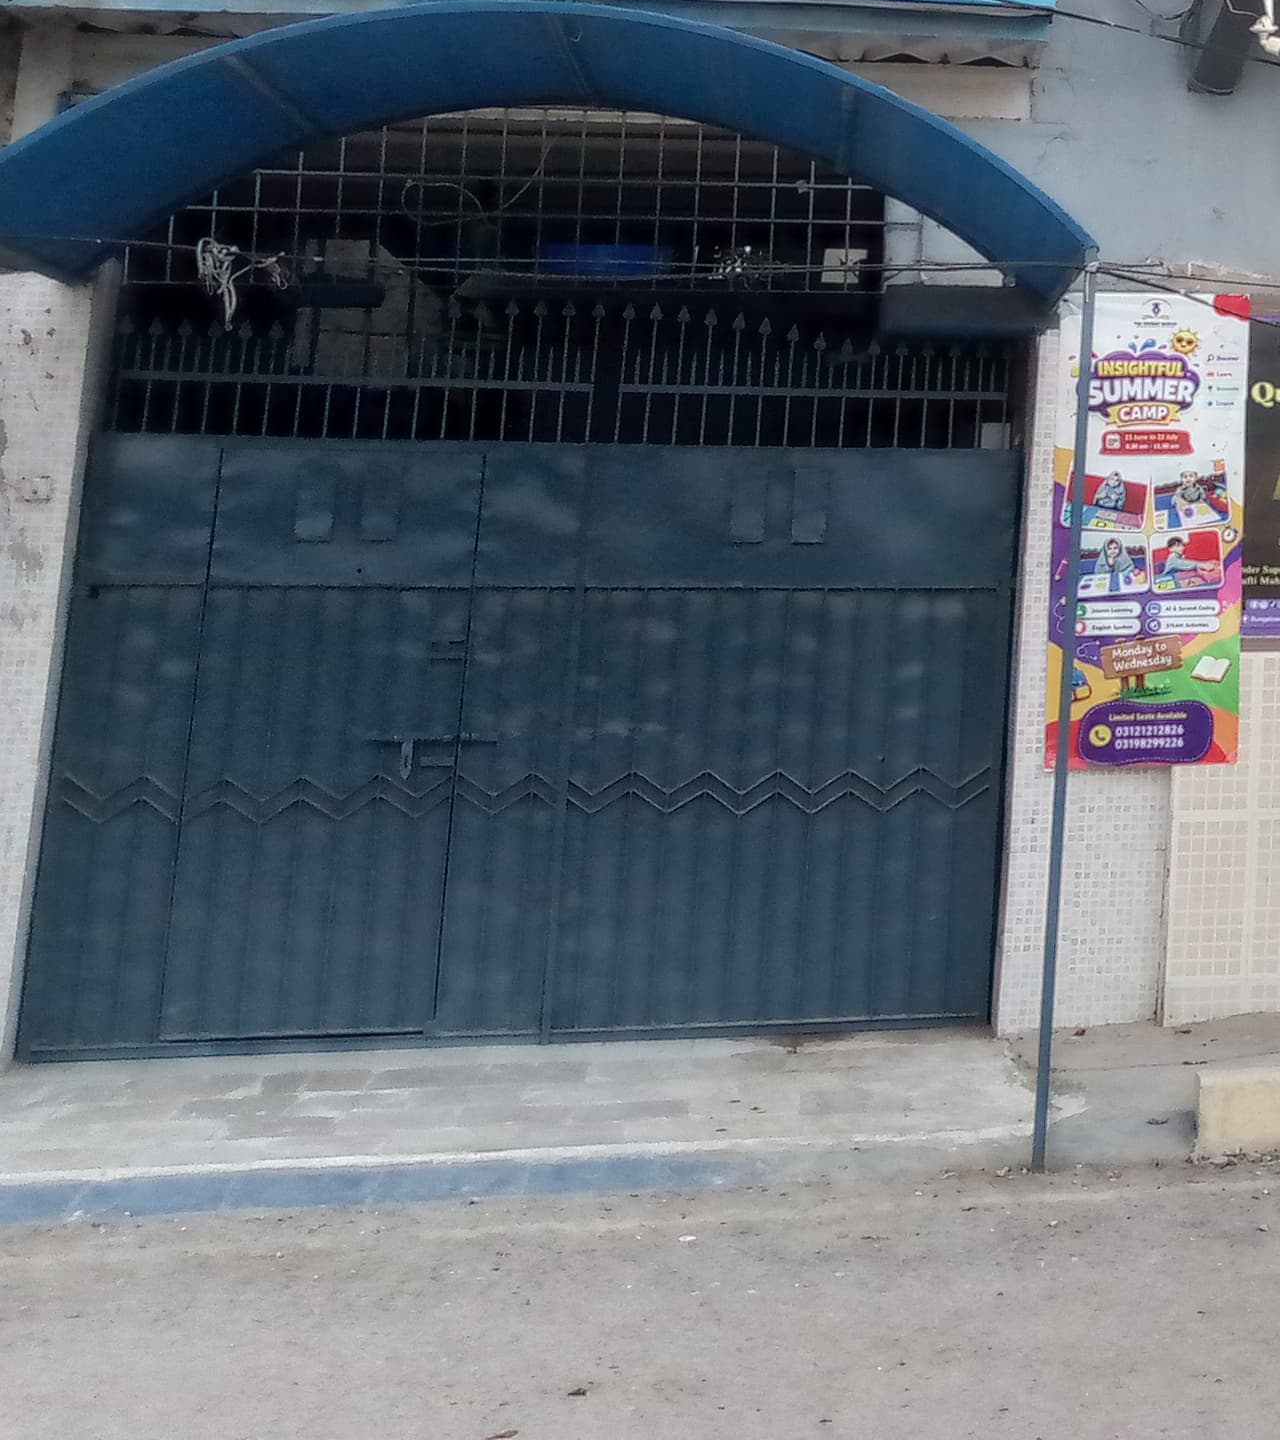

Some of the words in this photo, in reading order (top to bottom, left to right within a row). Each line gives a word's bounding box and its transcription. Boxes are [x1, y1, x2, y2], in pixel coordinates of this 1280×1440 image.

[1097, 360, 1184, 377] INSIGHTFUL
[1088, 377, 1196, 405] SUMMER
[1119, 405, 1168, 421] CAMP
[1112, 643, 1152, 658] Monday
[1155, 642, 1166, 652] to
[1113, 654, 1172, 672] Wednesday
[1109, 712, 1134, 721] Limited
[1136, 712, 1154, 720] Seats
[1156, 712, 1187, 720] Available
[1115, 724, 1184, 737] 03121212826
[1115, 737, 1184, 750] 03198299226
